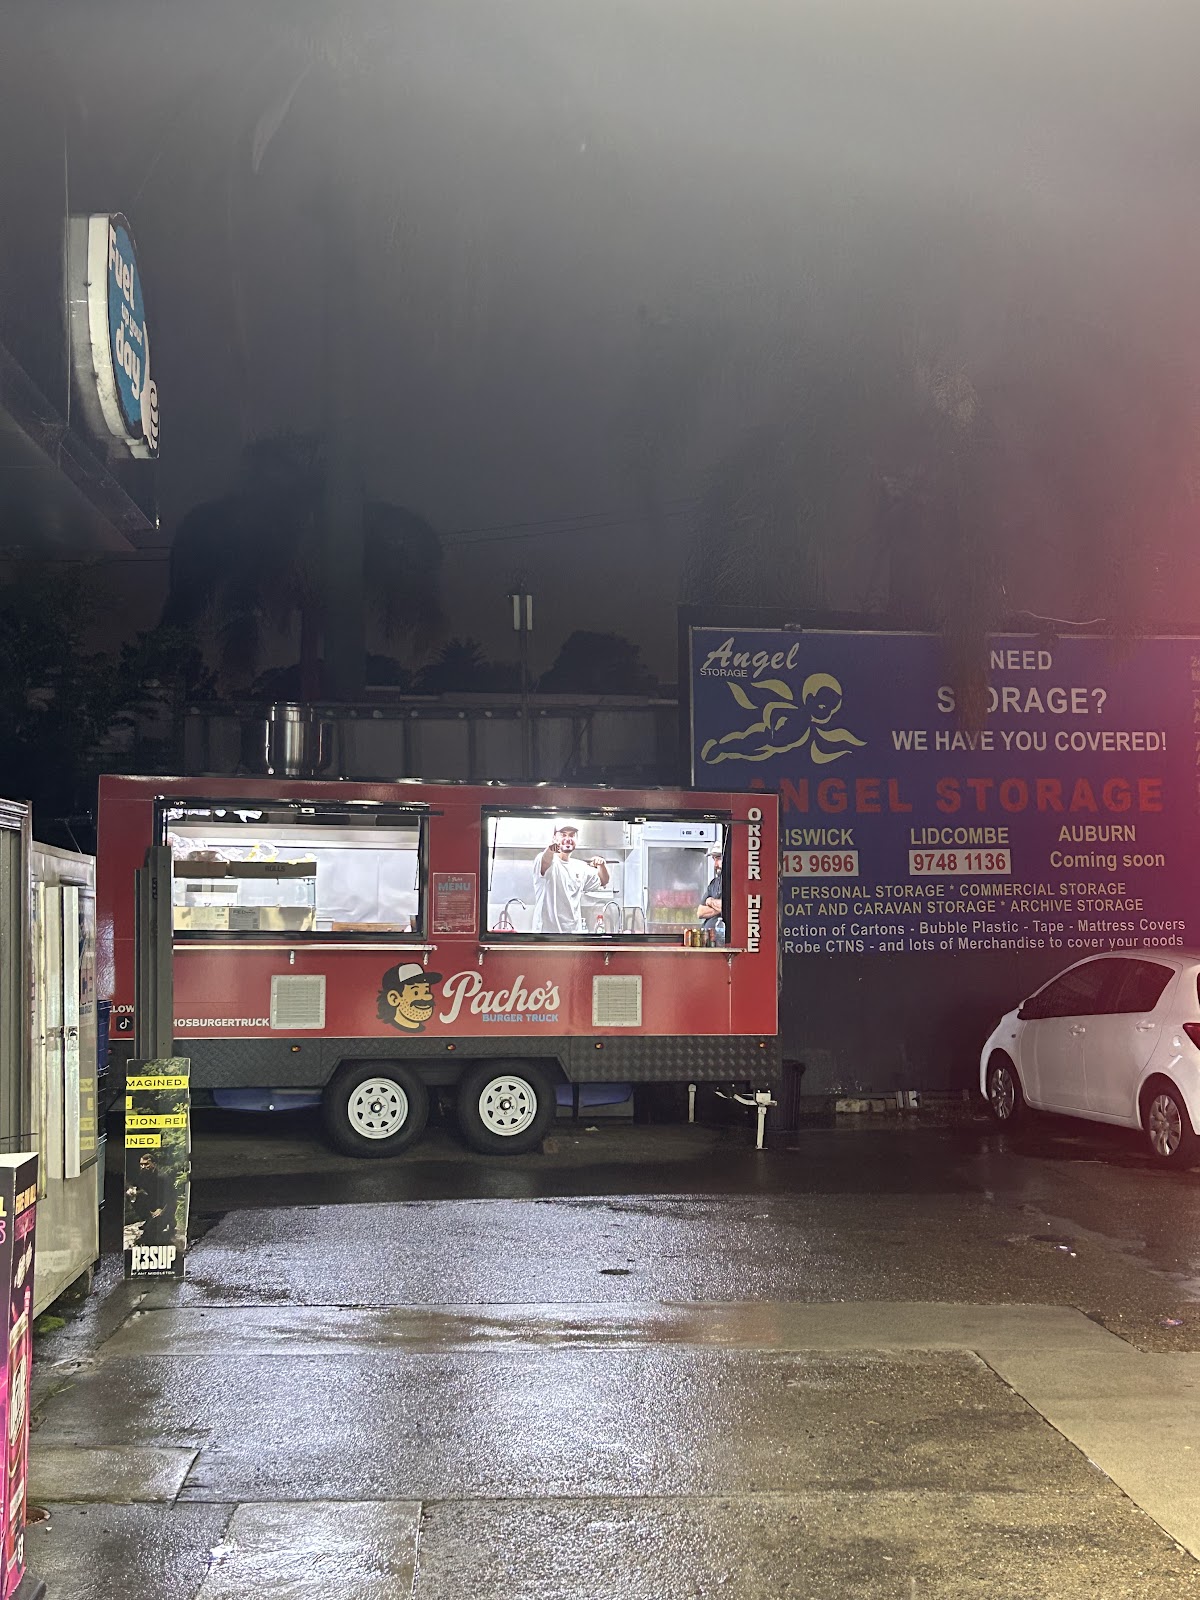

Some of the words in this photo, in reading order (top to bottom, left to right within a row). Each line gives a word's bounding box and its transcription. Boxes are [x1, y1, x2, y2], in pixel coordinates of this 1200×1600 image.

[108, 223, 135, 310] Fuel
[116, 320, 140, 400] day
[702, 637, 800, 678] Angel
[990, 650, 1053, 670] NEED
[700, 668, 748, 678] STORAGE
[937, 686, 1107, 714] SORAGE?
[892, 730, 928, 750] WE
[935, 730, 994, 750] HAVE
[1000, 731, 1047, 751] YOU
[1054, 732, 1167, 752] COVERED!
[936, 778, 1166, 813] STORAGE
[910, 827, 1010, 845] LIDCOMBE
[1058, 825, 1136, 842] AUBURN
[748, 807, 762, 880] ORDER
[809, 854, 854, 873] 9696
[913, 853, 958, 871] 9748
[964, 852, 1006, 870] 1136
[1050, 850, 1117, 872] Coming
[1122, 854, 1166, 868] soon
[438, 882, 472, 891] MENU
[791, 886, 870, 899] PERSONAL
[875, 884, 945, 898] STORAGE
[960, 883, 1055, 897] COMMERCIAL
[1059, 882, 1126, 896] STORAGE
[818, 903, 848, 916] AND
[853, 902, 922, 915] CARAVAN
[927, 900, 996, 914] STORAGE
[1010, 900, 1072, 912] ARCHIVE
[1076, 898, 1144, 912] STORAGE
[748, 894, 762, 953] HERE
[832, 924, 846, 936] of
[850, 922, 905, 936] Cartons
[919, 921, 968, 935] Bubble
[972, 920, 1019, 934] Plastic
[1032, 920, 1064, 934] Tape
[1078, 919, 1135, 932] Mattress
[1139, 918, 1186, 931] Covers
[826, 940, 865, 952] CTNS
[878, 938, 904, 952] and
[909, 938, 935, 951] lots
[940, 937, 954, 950] of
[958, 936, 1045, 950] Merchandise
[1049, 937, 1062, 948] to
[1068, 938, 1104, 948] cover
[1108, 936, 1138, 950] your
[1142, 934, 1184, 948] goods
[439, 970, 560, 1024] Pacho's
[110, 1005, 134, 1013] LOW
[482, 1014, 523, 1022] BURGER
[526, 1014, 558, 1022] TRUCK
[126, 1118, 160, 1126] TION.
[132, 1246, 176, 1270] R3SUP
